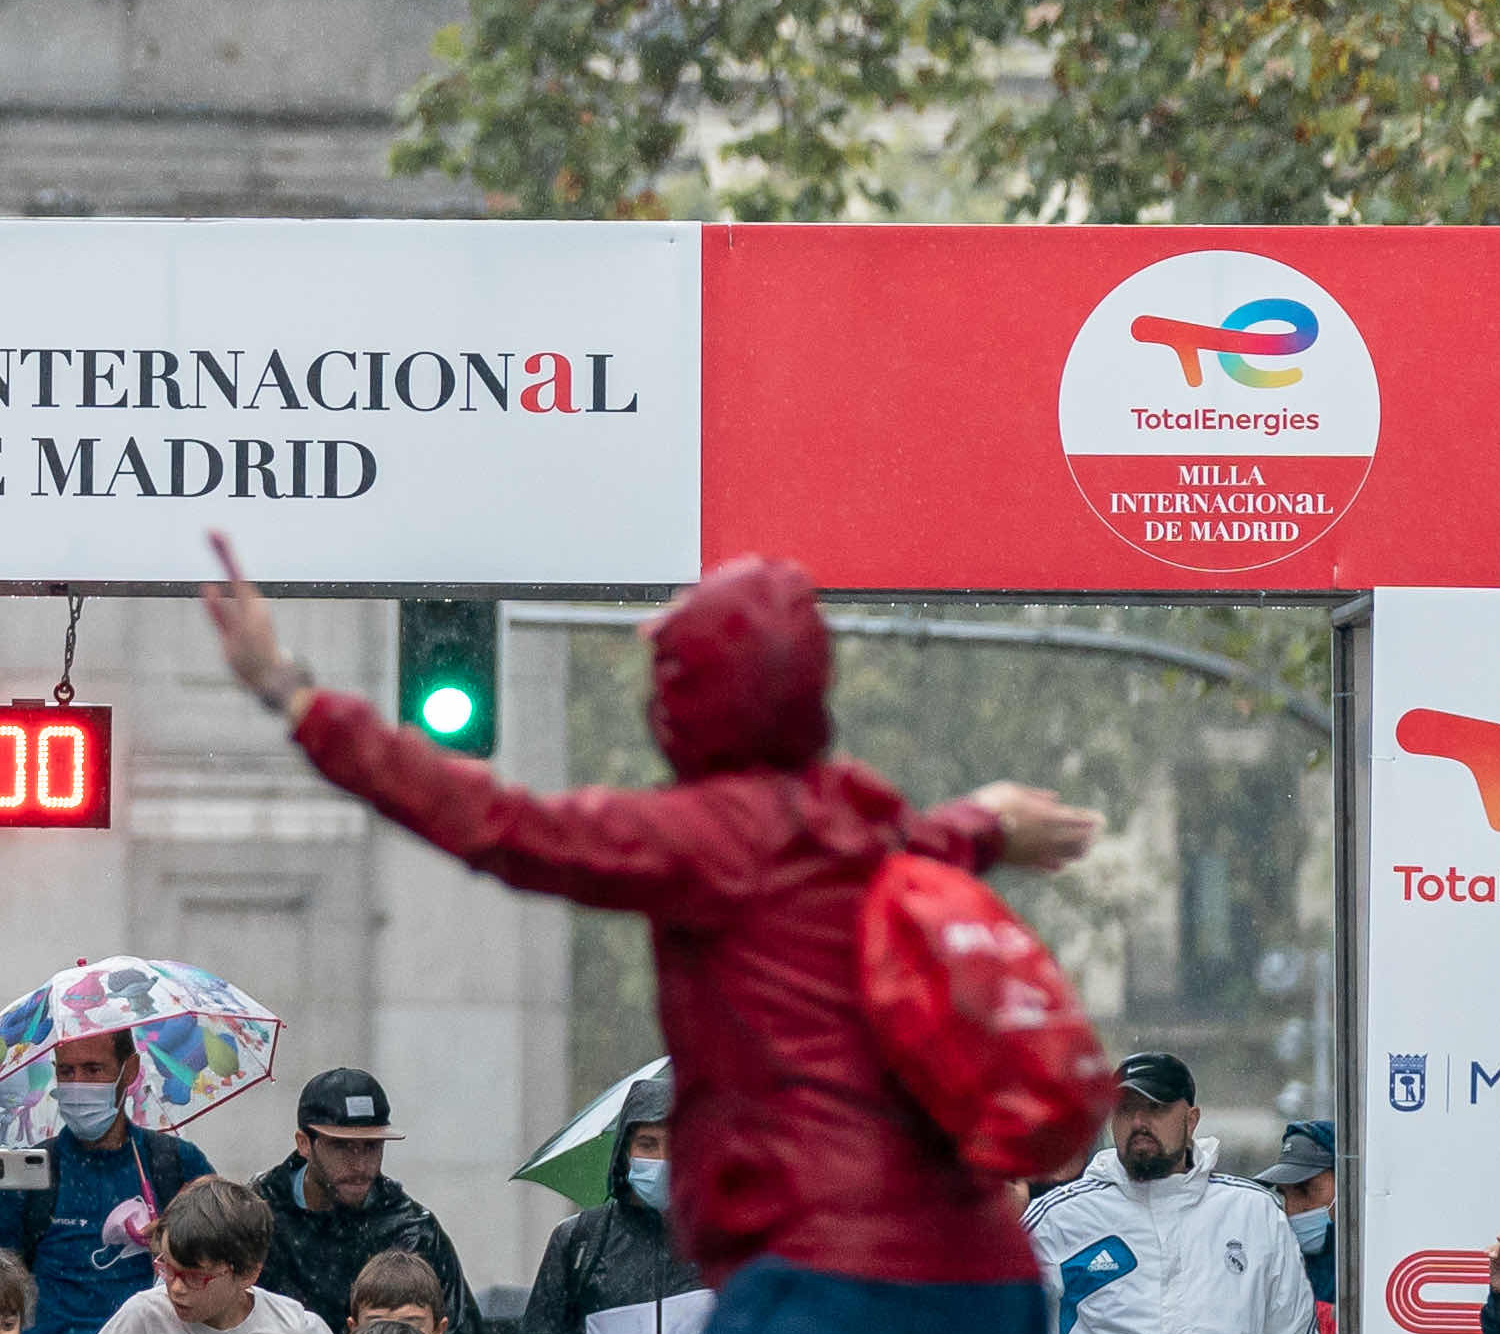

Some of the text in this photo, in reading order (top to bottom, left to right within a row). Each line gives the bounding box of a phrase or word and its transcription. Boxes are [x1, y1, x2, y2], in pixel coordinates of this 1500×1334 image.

[1131, 408, 1320, 436] TotalEnergies
[31, 437, 377, 499] MADRID
[1179, 465, 1266, 486] MILLA
[1145, 521, 1299, 543] DE MADRID
